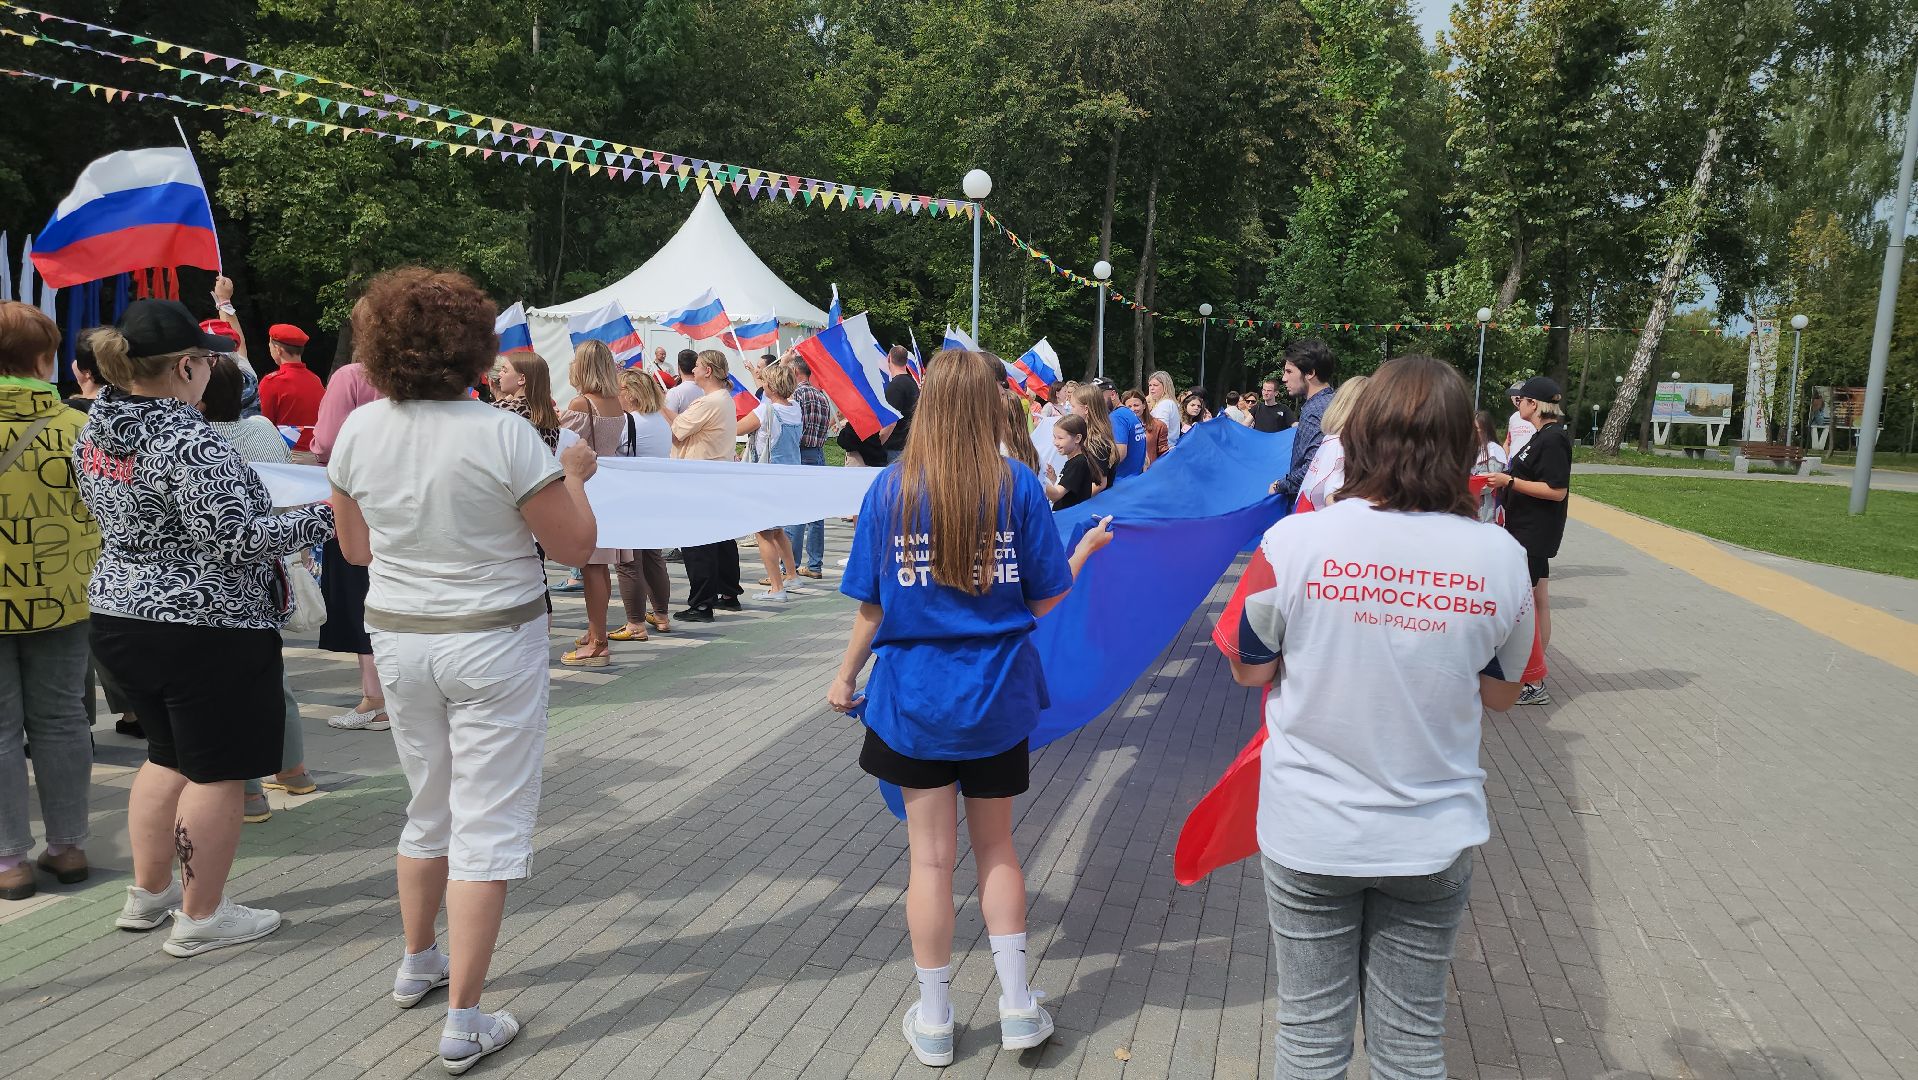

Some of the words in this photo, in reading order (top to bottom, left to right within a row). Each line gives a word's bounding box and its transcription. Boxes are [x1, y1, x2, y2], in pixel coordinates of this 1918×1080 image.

[1323, 559, 1485, 593] ВОЛОНТЕРЫ
[1306, 581, 1497, 617] ПОДМОСКОВЬЯ
[1354, 611, 1382, 626] МЫ
[1384, 613, 1447, 634] РЯДОМ
